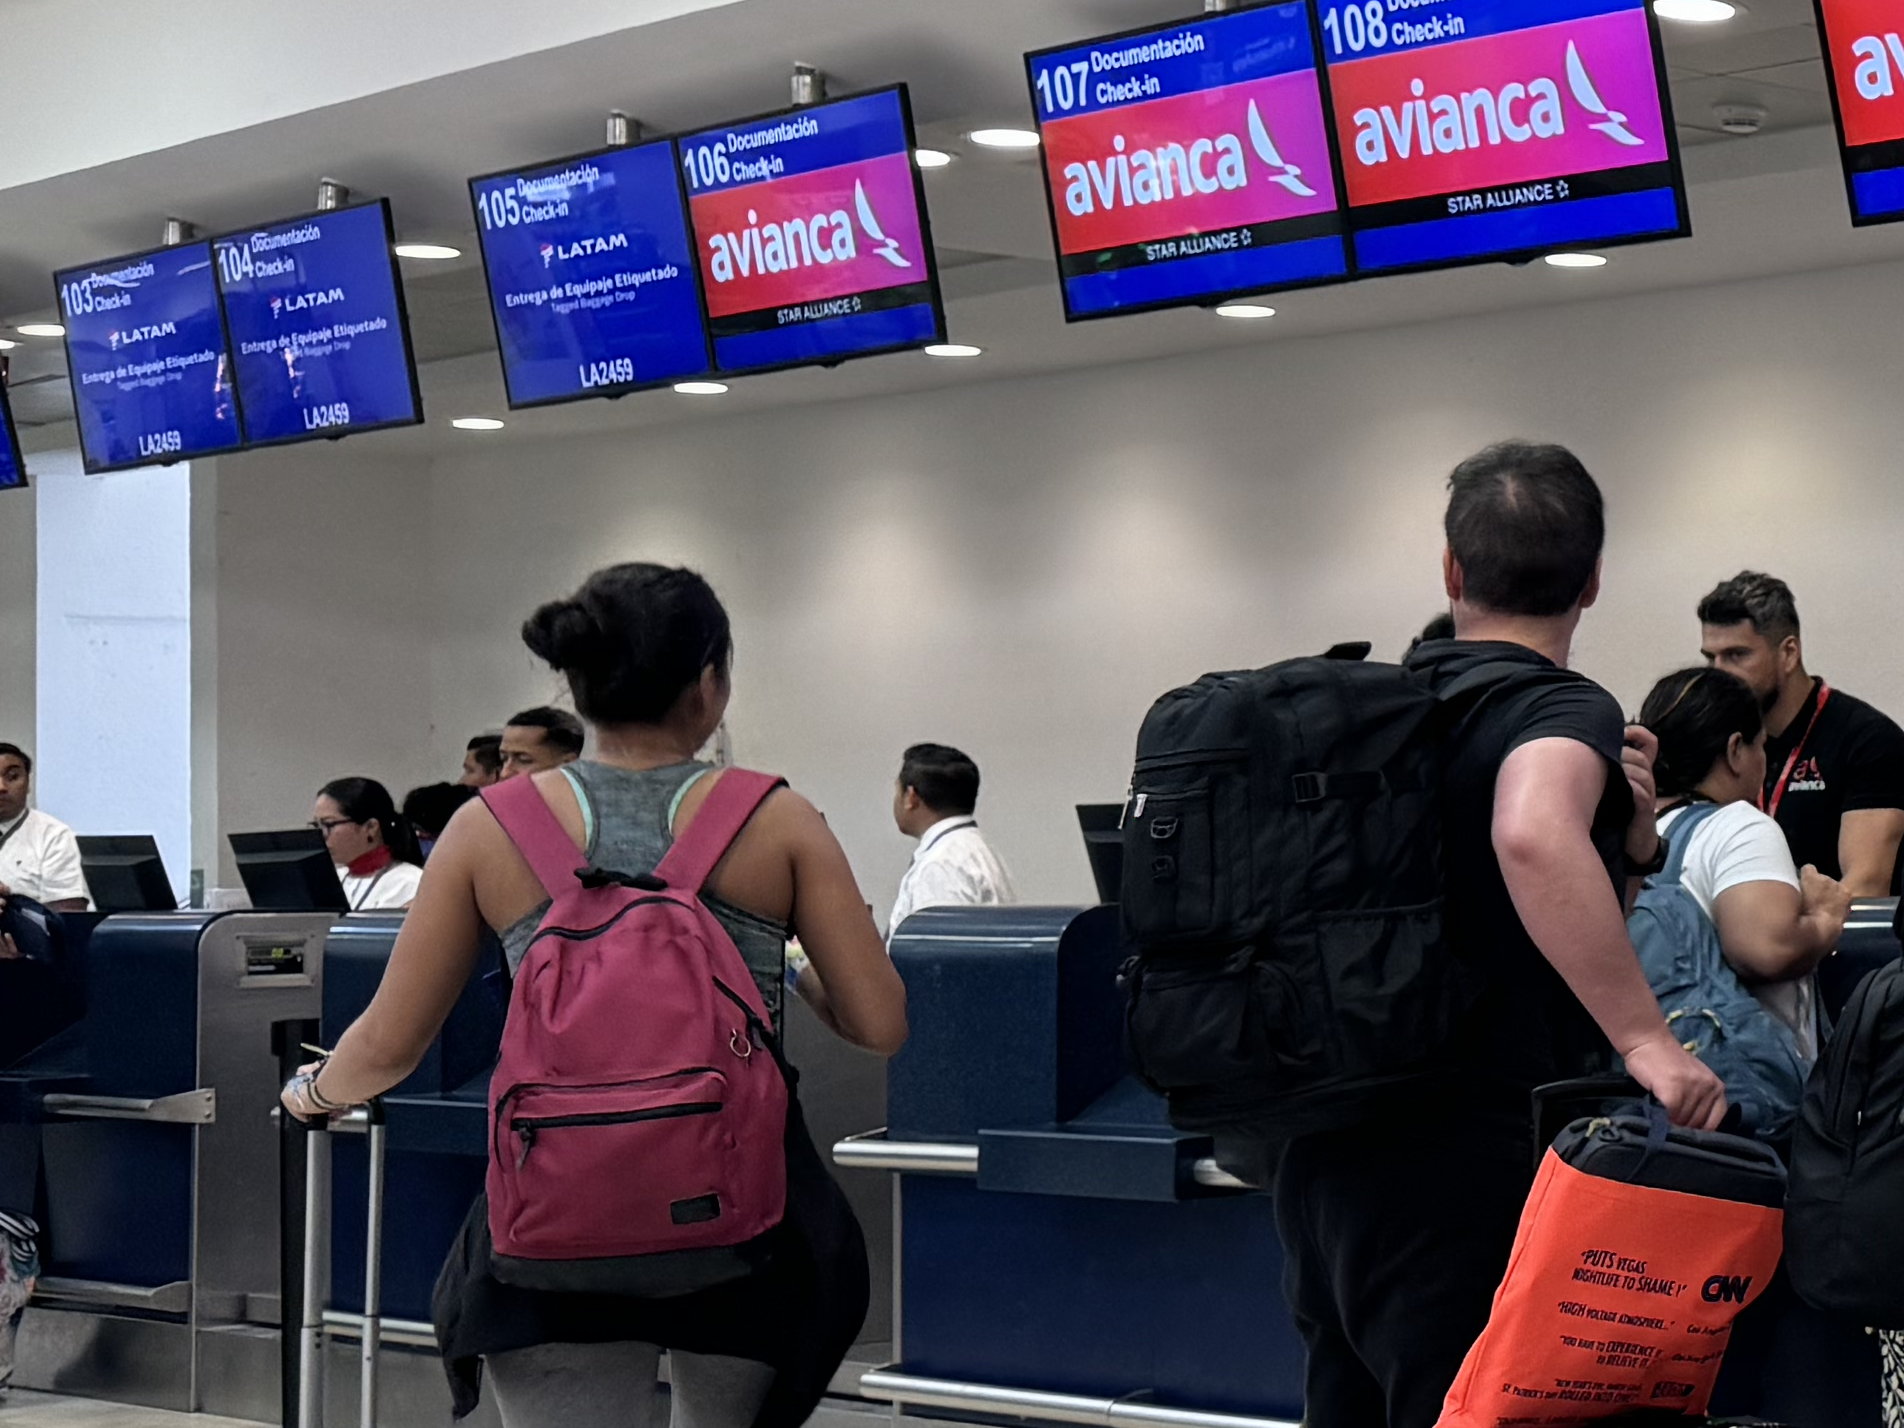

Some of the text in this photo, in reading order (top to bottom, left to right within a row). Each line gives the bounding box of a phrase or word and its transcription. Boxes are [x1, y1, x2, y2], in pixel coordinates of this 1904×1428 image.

[1323, 0, 1388, 54] 108
[1391, 14, 1465, 46] Check-in
[1091, 31, 1204, 73] Documentación
[1037, 61, 1090, 113] 107
[1096, 74, 1160, 104] Check-in
[727, 117, 818, 153] Documentación
[1353, 77, 1565, 166] avianca
[684, 142, 730, 189] 106
[733, 154, 783, 182] Check-in
[1063, 133, 1247, 216] avianca
[479, 186, 520, 230] 105
[522, 201, 568, 224] Check-in
[1447, 183, 1553, 214] STAR ALLIANCE
[251, 223, 320, 253] Documentación
[558, 233, 628, 260] LATAM
[709, 209, 856, 283] avianca
[1147, 232, 1238, 260] STAR ALLIANCE
[219, 243, 253, 283] 104
[256, 255, 294, 277] Check-in
[61, 281, 93, 317] 103
[285, 288, 344, 311] LATAM
[506, 265, 678, 308] Entrega de Equipaje Etiquetado
[95, 293, 131, 312] Check-in
[777, 298, 850, 325] STAR ALLIANCE
[122, 322, 176, 344] LATAM
[241, 338, 278, 354] Entrega
[334, 316, 386, 337] Etiquetado
[579, 357, 633, 388] LA2459
[304, 402, 350, 429] LA2459
[139, 430, 181, 456] LA2459
[1617, 1257, 1647, 1274] VEGAS
[1572, 1268, 1620, 1288] NIGHTLIFE
[1622, 1275, 1635, 1290] TO
[1636, 1276, 1675, 1296] SHAME
[1701, 1275, 1752, 1304] CNN
